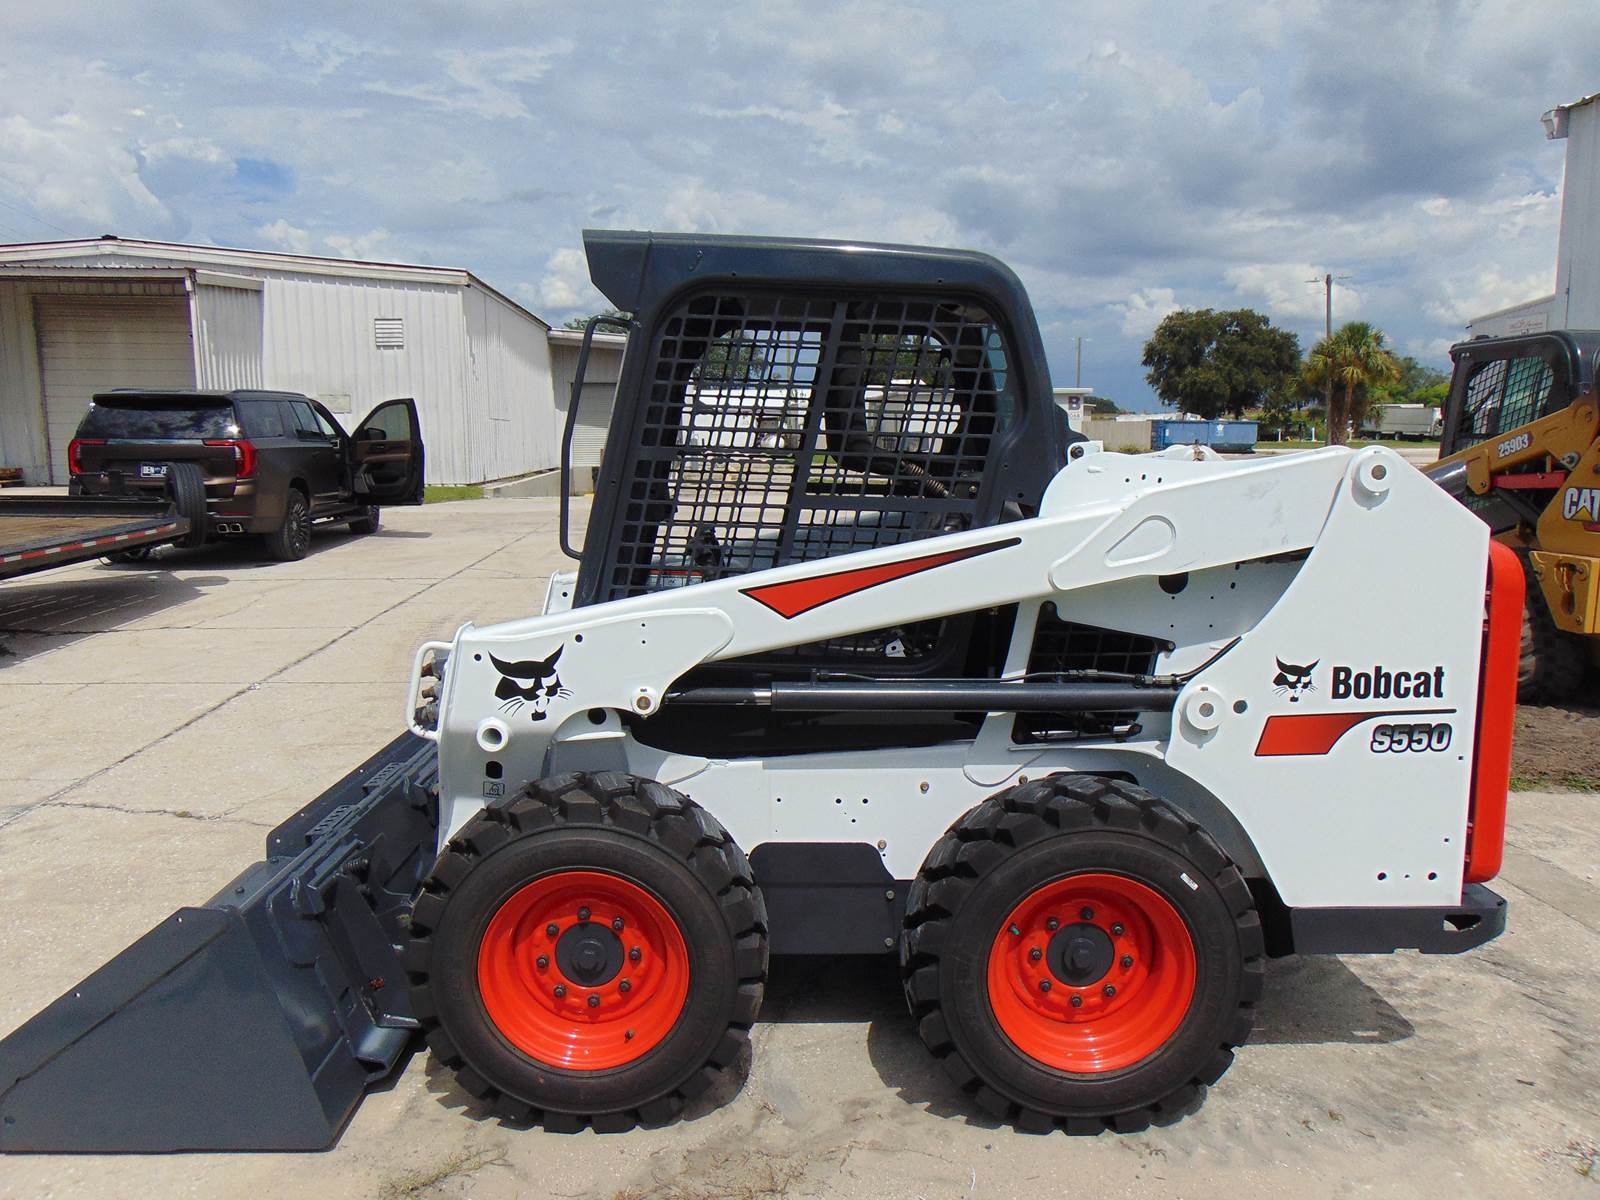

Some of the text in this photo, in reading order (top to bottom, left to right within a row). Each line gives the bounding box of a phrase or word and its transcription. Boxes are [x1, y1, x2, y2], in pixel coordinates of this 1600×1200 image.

[1498, 432, 1531, 458] 259D3
[1563, 487, 1600, 522] CAT
[1331, 665, 1445, 699] Bobcat
[1370, 722, 1452, 754] S550
